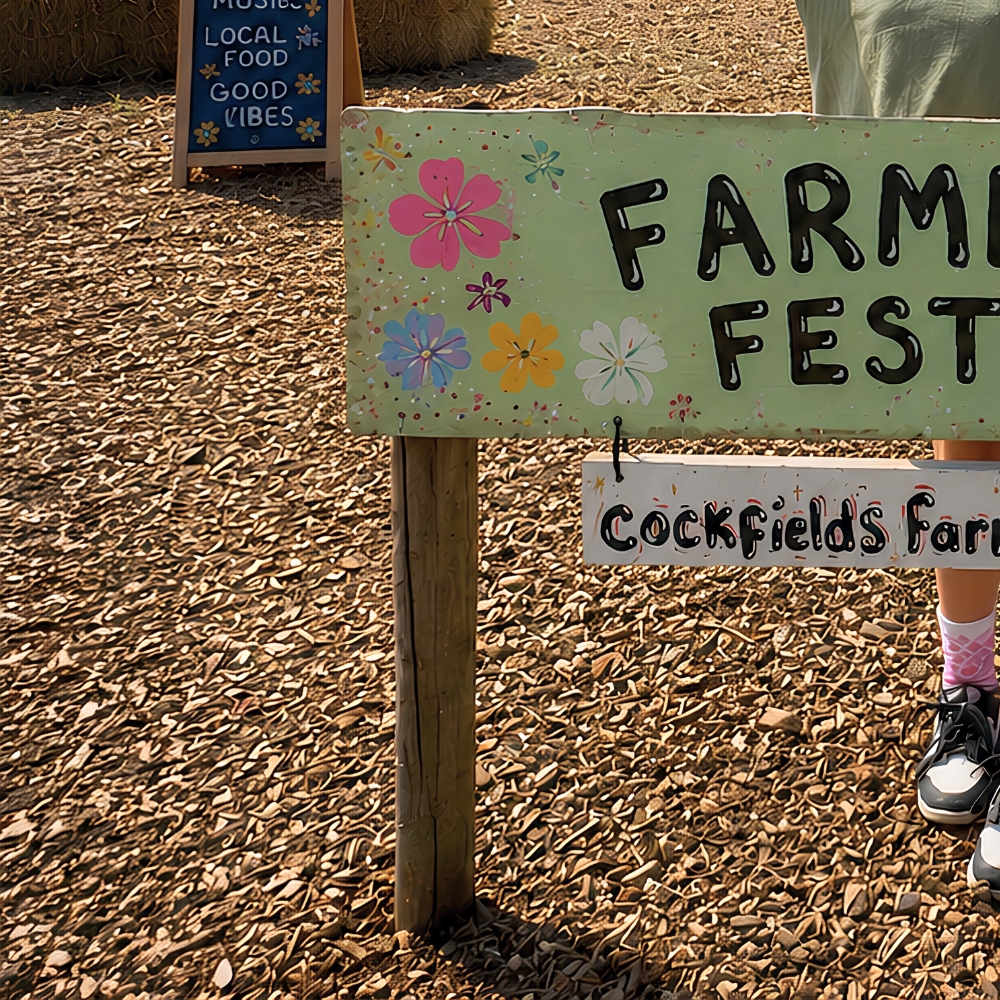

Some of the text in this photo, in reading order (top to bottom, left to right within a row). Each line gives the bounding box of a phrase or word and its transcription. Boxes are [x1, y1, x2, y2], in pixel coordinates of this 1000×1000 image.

[205, 25, 287, 47] LOCAL
[224, 49, 288, 67] FOOD
[210, 80, 288, 102] GOOD
